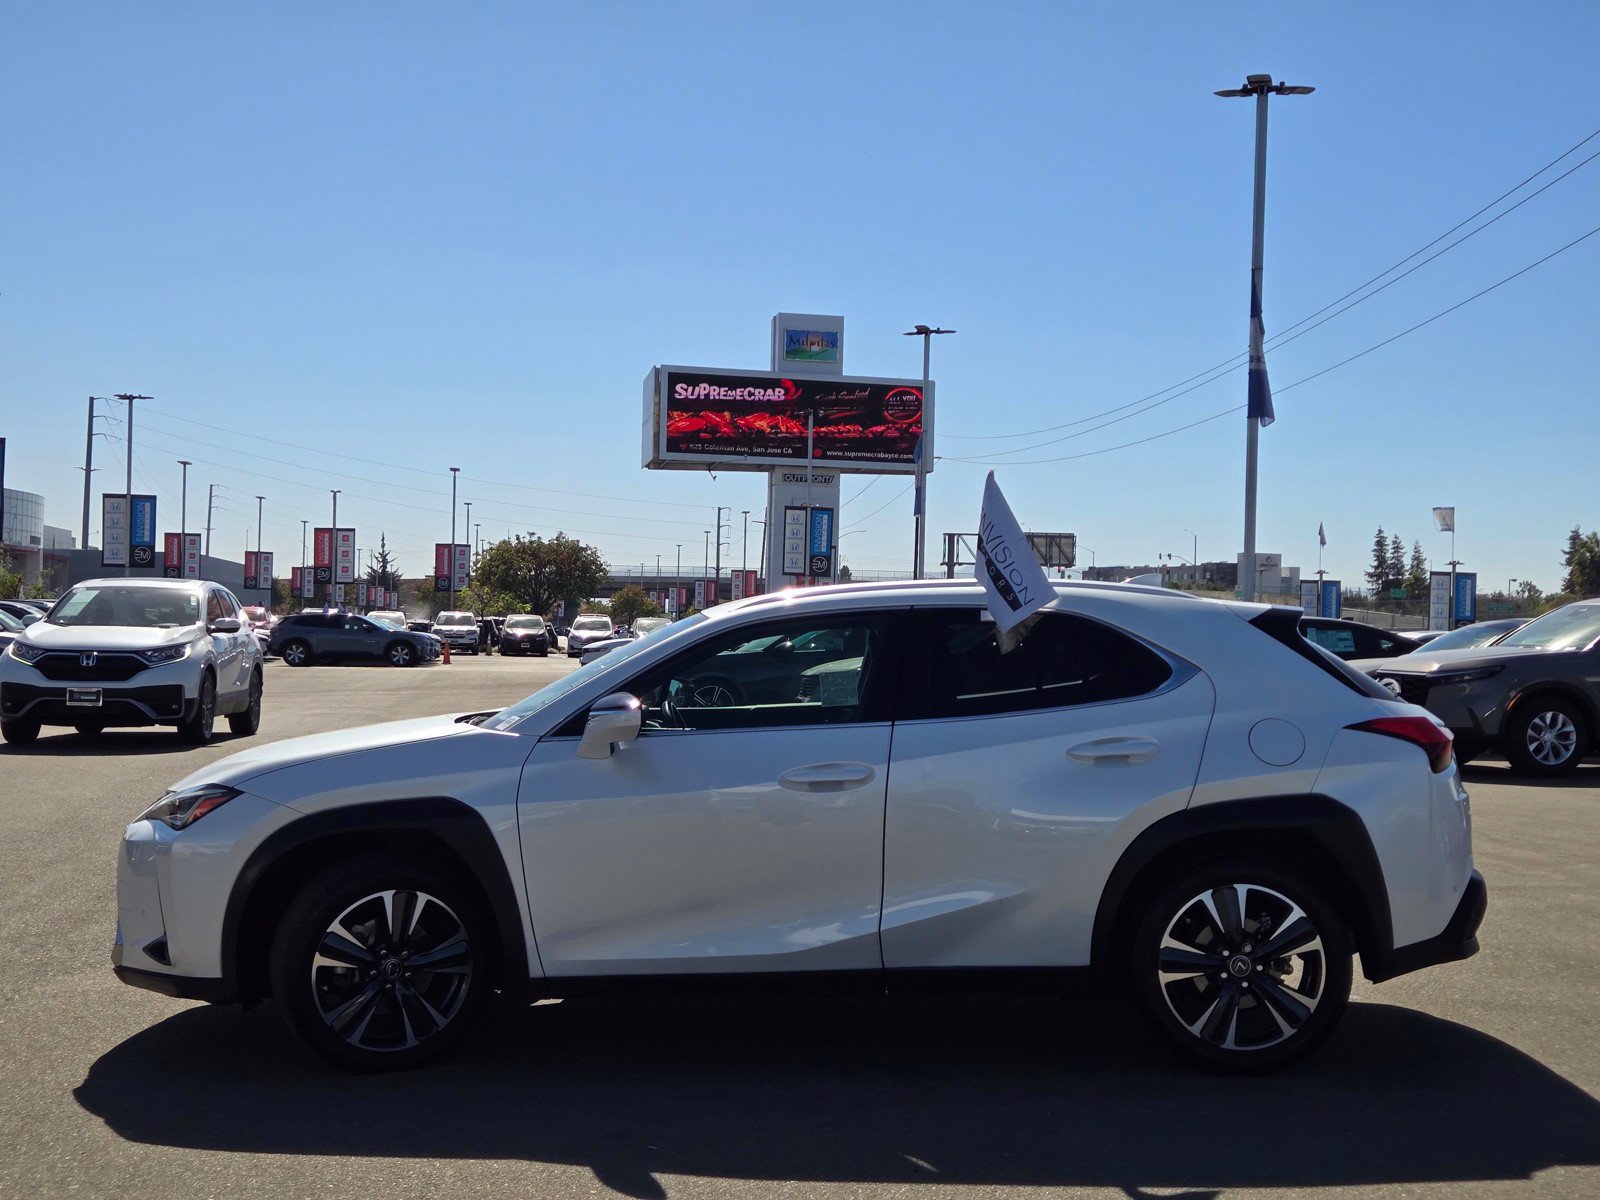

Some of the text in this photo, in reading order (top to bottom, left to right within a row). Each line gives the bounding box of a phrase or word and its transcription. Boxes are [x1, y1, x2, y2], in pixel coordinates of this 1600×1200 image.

[826, 450, 914, 460] www.supremecrabayce.com
[136, 501, 145, 542] ENVISION
[813, 513, 823, 552] ENVISION
[981, 510, 1035, 606] NVISION
